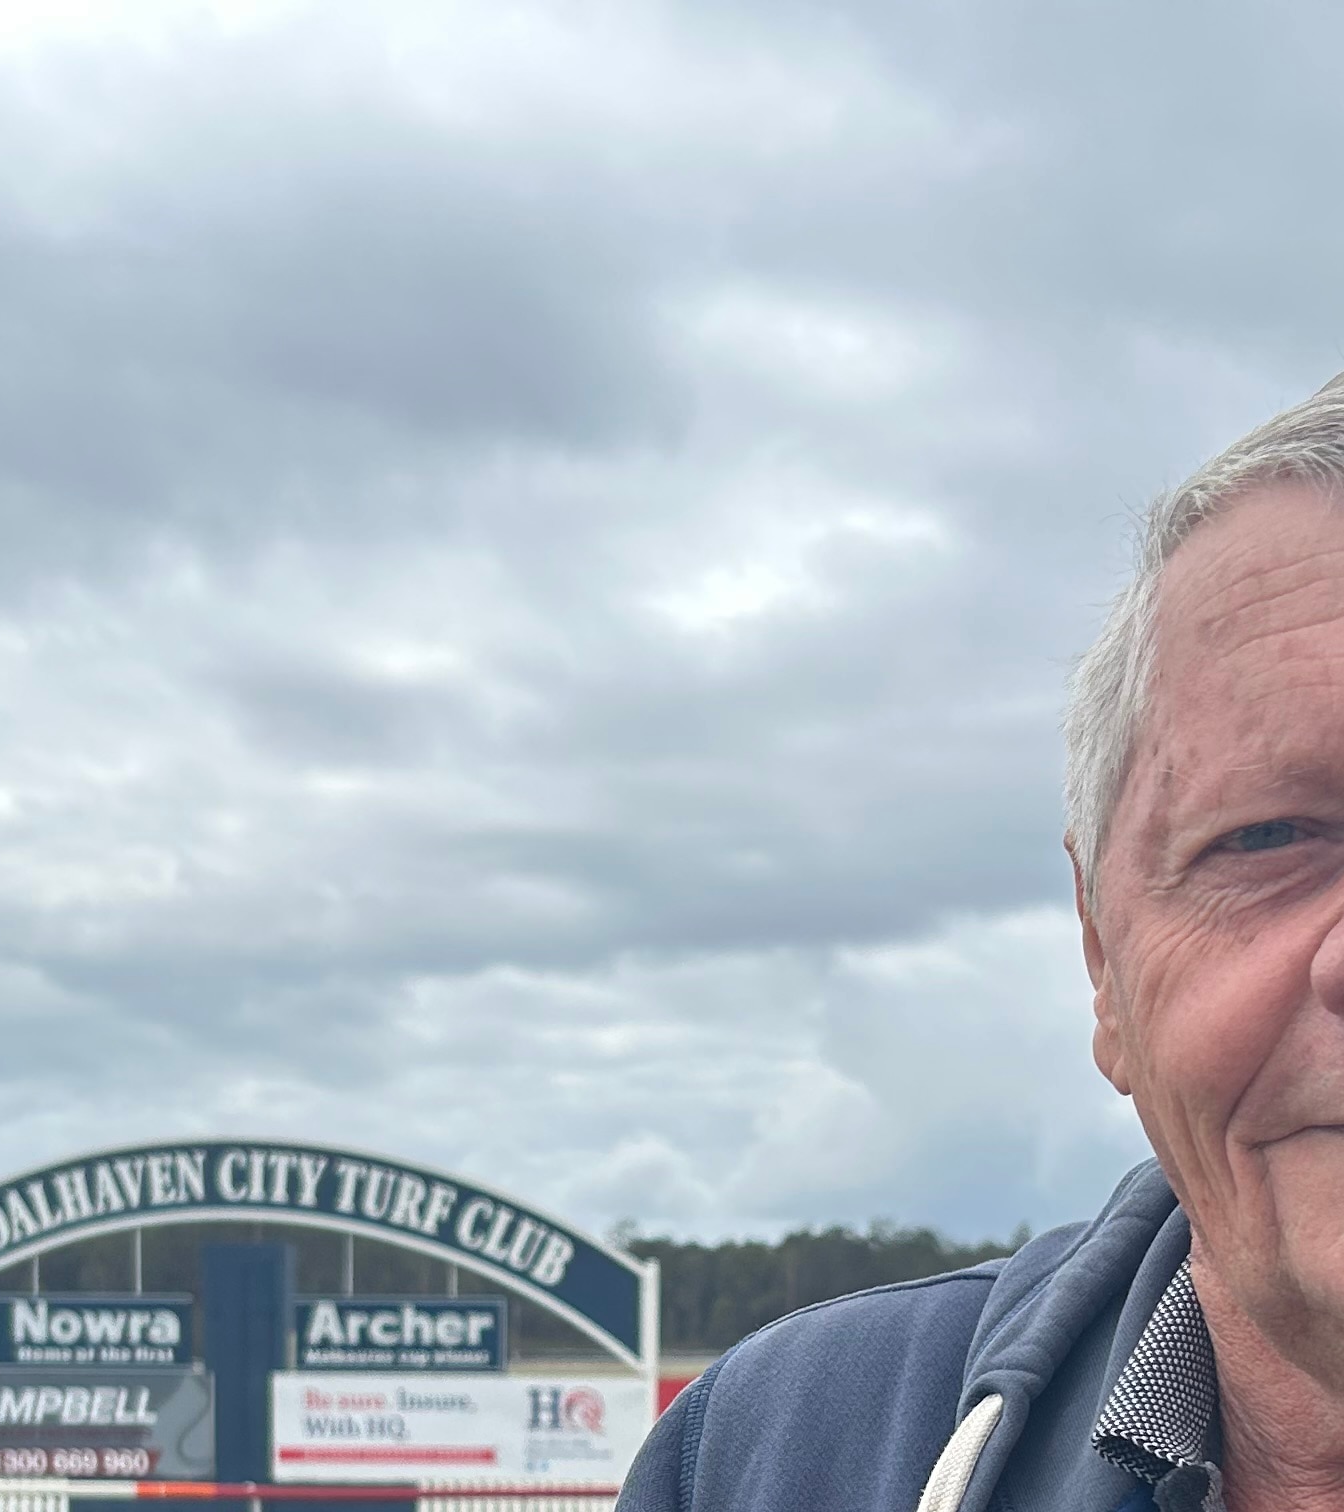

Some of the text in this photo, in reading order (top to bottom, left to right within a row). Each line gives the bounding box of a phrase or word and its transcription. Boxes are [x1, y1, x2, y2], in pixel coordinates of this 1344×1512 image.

[217, 1149, 328, 1208] CITY
[335, 1161, 456, 1236] TURF
[457, 1196, 574, 1287] CLUB
[12, 1298, 181, 1346] Nowra
[307, 1299, 495, 1347] Archer
[527, 1384, 607, 1437] HQ
